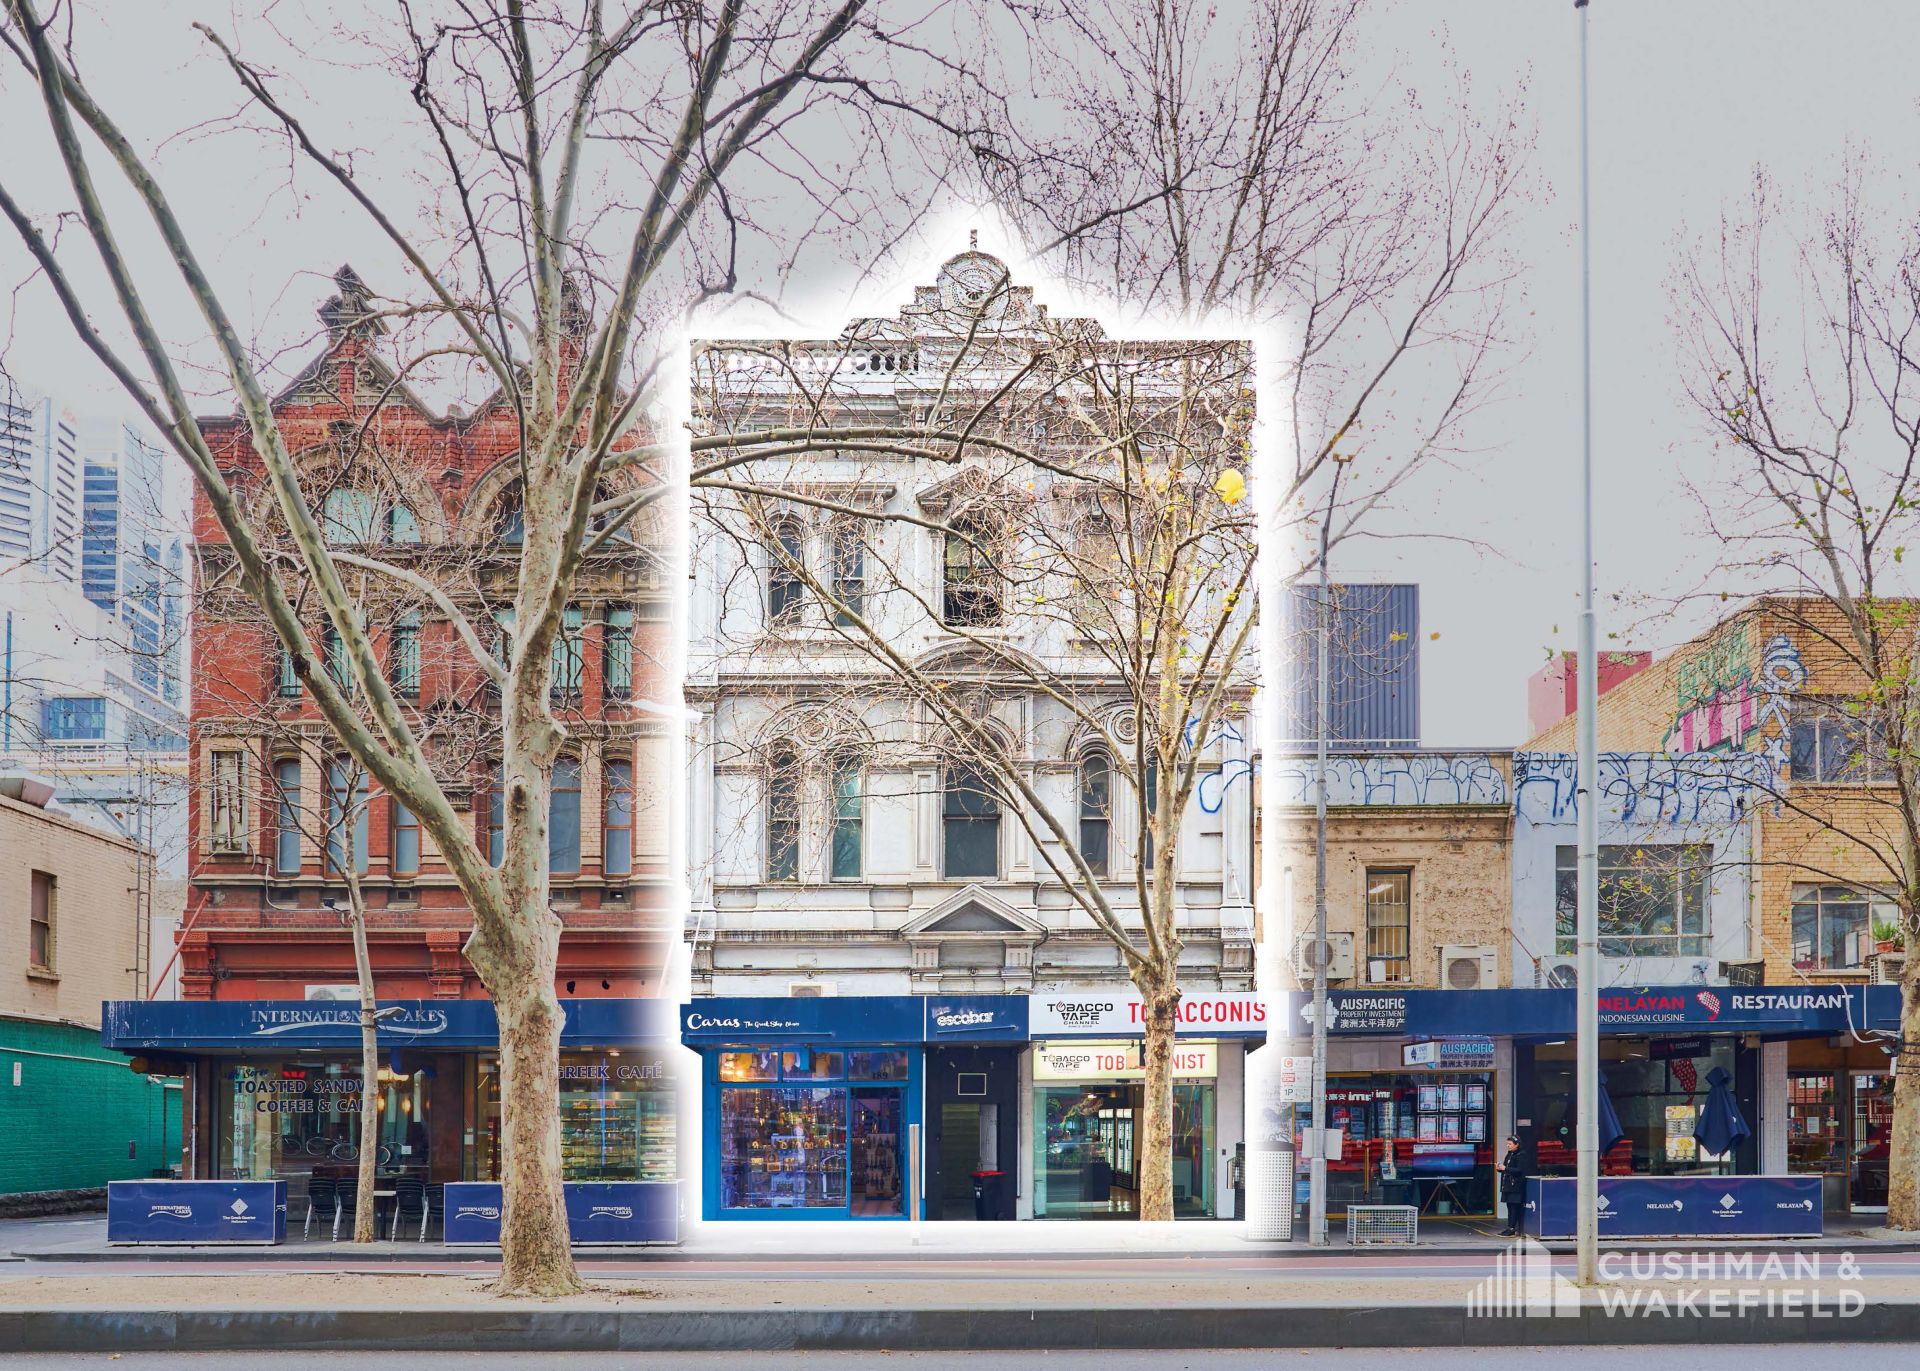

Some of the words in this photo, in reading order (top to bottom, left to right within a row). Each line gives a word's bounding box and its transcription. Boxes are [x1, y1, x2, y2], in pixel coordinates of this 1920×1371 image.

[1047, 1001, 1114, 1013] TOBACCO
[1340, 998, 1405, 1010] AUSPACIFIC
[1598, 996, 1685, 1011] NELAYAN
[1732, 994, 1854, 1010] RESTAURANT
[937, 1010, 994, 1026] escobar
[1061, 1012, 1100, 1021] VAPE
[1340, 1010, 1368, 1018] PROPERTY
[1369, 1010, 1405, 1018] INVESTMENT
[1599, 1014, 1651, 1023] INDONESIAN
[1652, 1013, 1685, 1022] CUISINE
[687, 1013, 740, 1030] Caras
[1340, 1018, 1405, 1029] 澳洲太平洋房产
[1440, 1043, 1495, 1054] AUSPACIFIC
[1042, 1055, 1090, 1063] TOBACCO
[616, 1061, 664, 1079] CAFÉ
[236, 1079, 307, 1094] TOASTED
[256, 1099, 314, 1113] COFFEE
[317, 1099, 332, 1113] &
